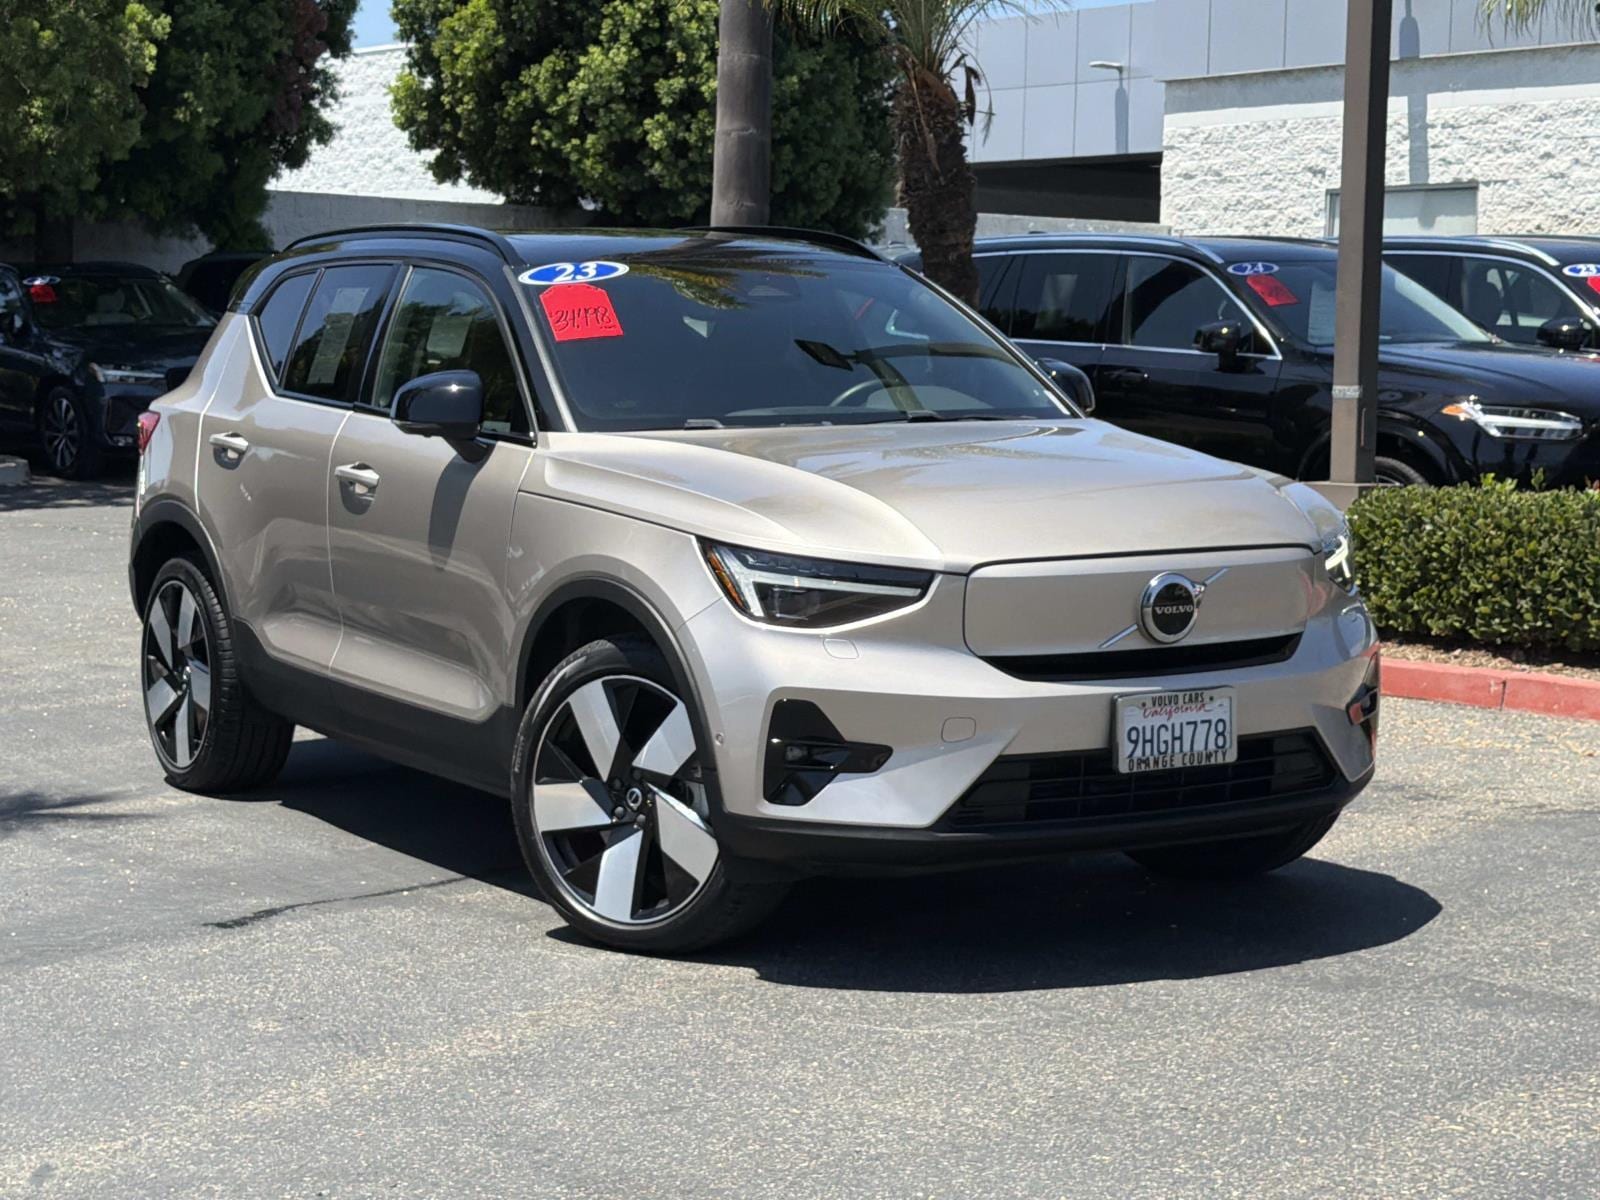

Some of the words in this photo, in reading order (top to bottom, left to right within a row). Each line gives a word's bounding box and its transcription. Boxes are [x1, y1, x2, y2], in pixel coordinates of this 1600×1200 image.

[553, 262, 597, 282] 23
[1242, 263, 1264, 275] 24
[1155, 604, 1194, 615] VOLVO
[1151, 694, 1179, 707] VOLVO
[1183, 692, 1205, 704] CARS
[1143, 702, 1213, 720] California
[1127, 718, 1227, 759] 9HGH778
[1128, 755, 1175, 771] ORANGE
[1182, 750, 1229, 765] COUNTY
